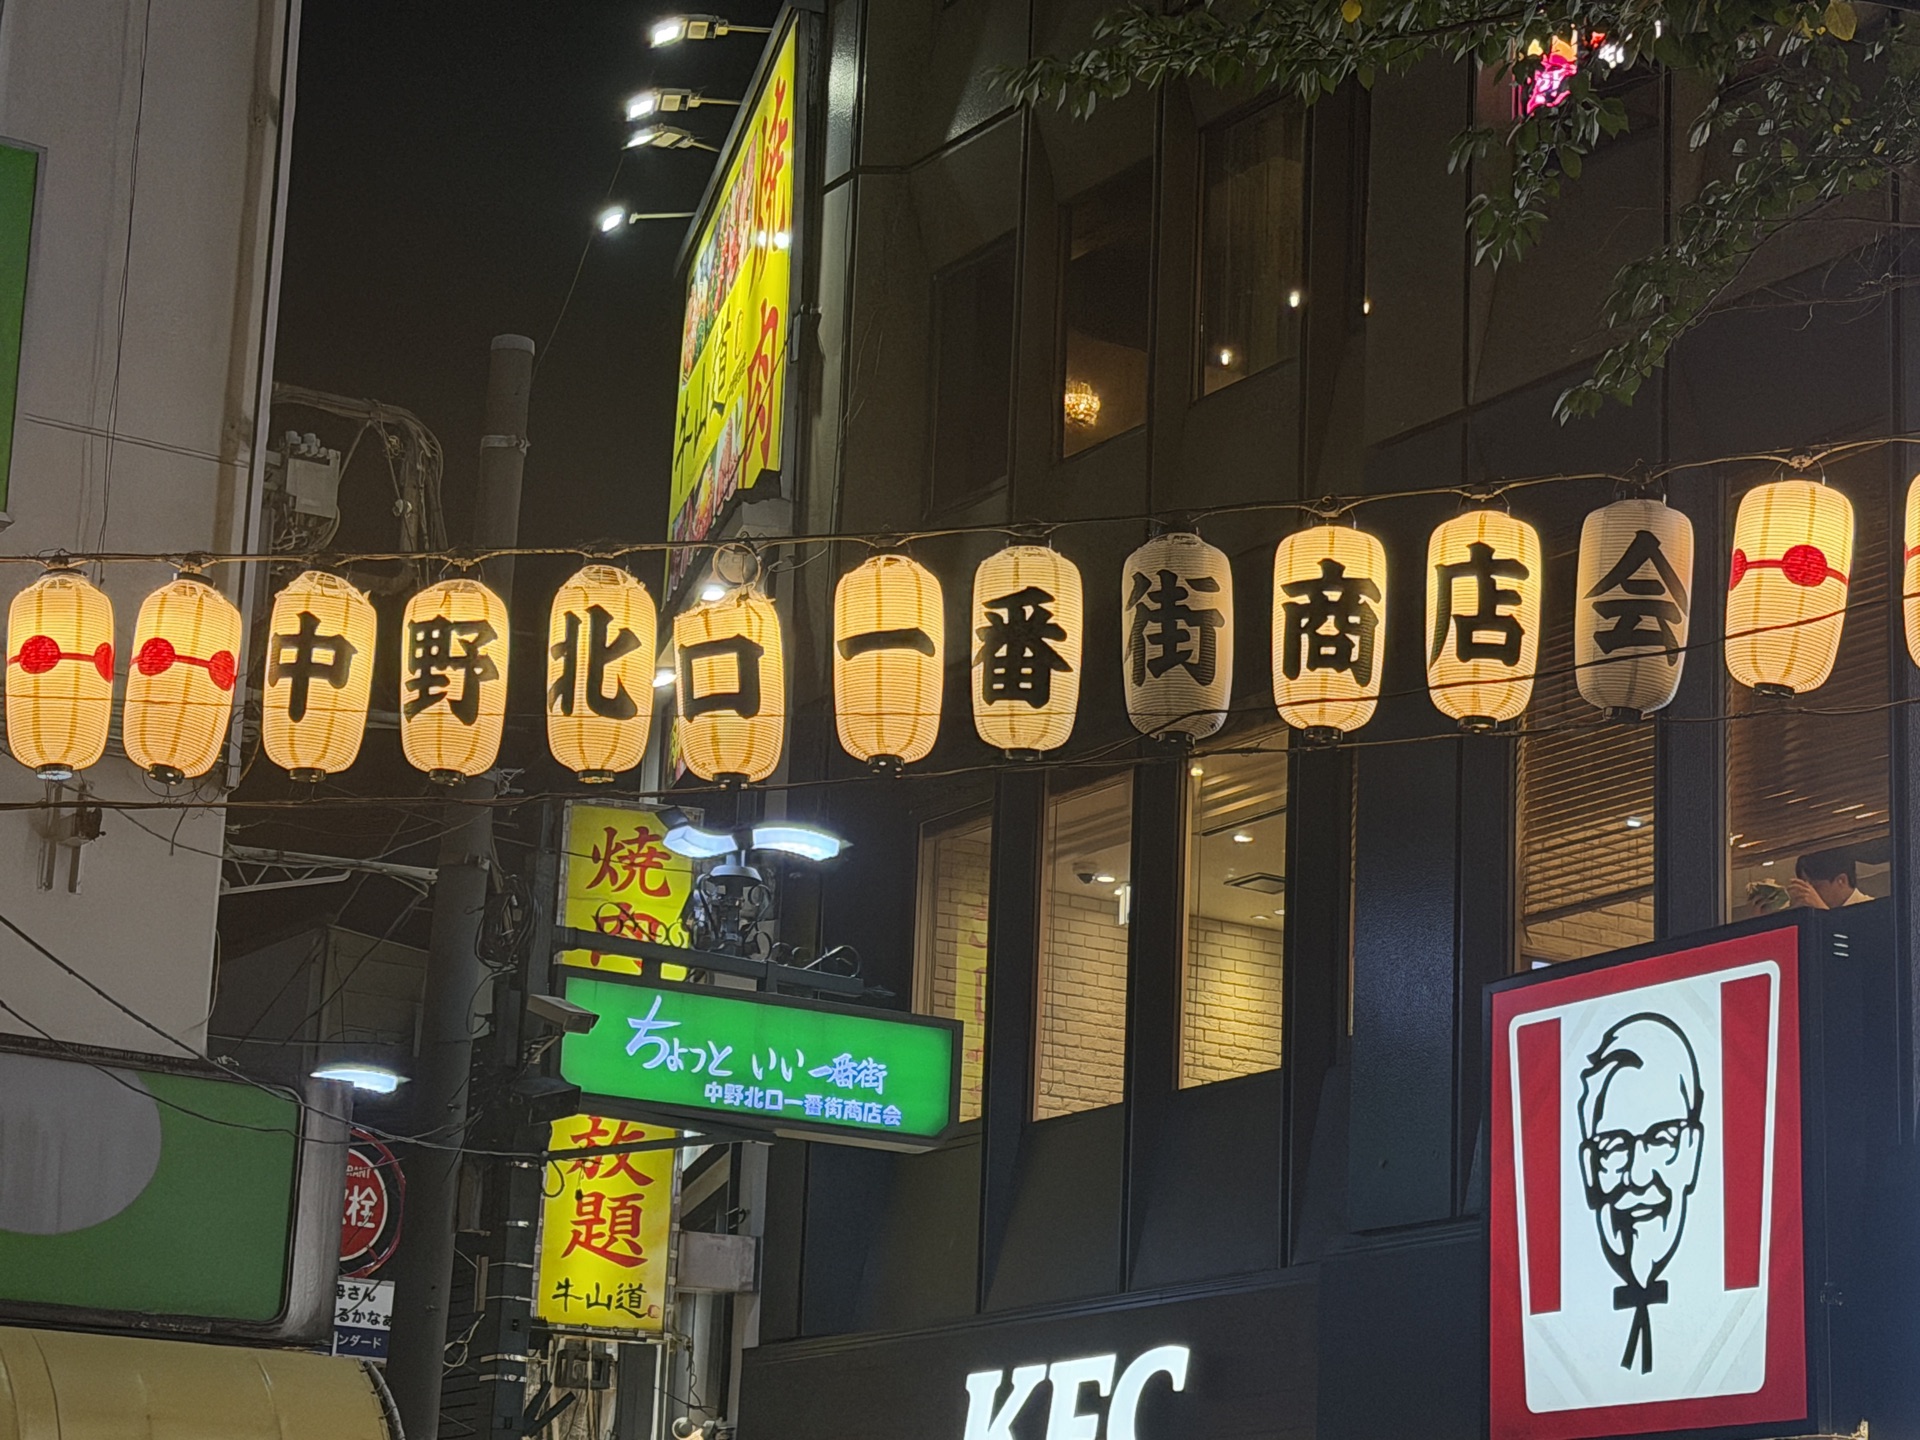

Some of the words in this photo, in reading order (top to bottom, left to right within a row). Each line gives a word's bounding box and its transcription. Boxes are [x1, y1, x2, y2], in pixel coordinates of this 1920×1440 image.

[268, 531, 1688, 726] 中野北口一番街商店会
[625, 994, 734, 1077] ちょっと
[704, 1081, 902, 1126] 中野北口一番街商店会
[551, 1277, 649, 1319] 牛山道
[963, 1345, 1190, 1440] KFC
